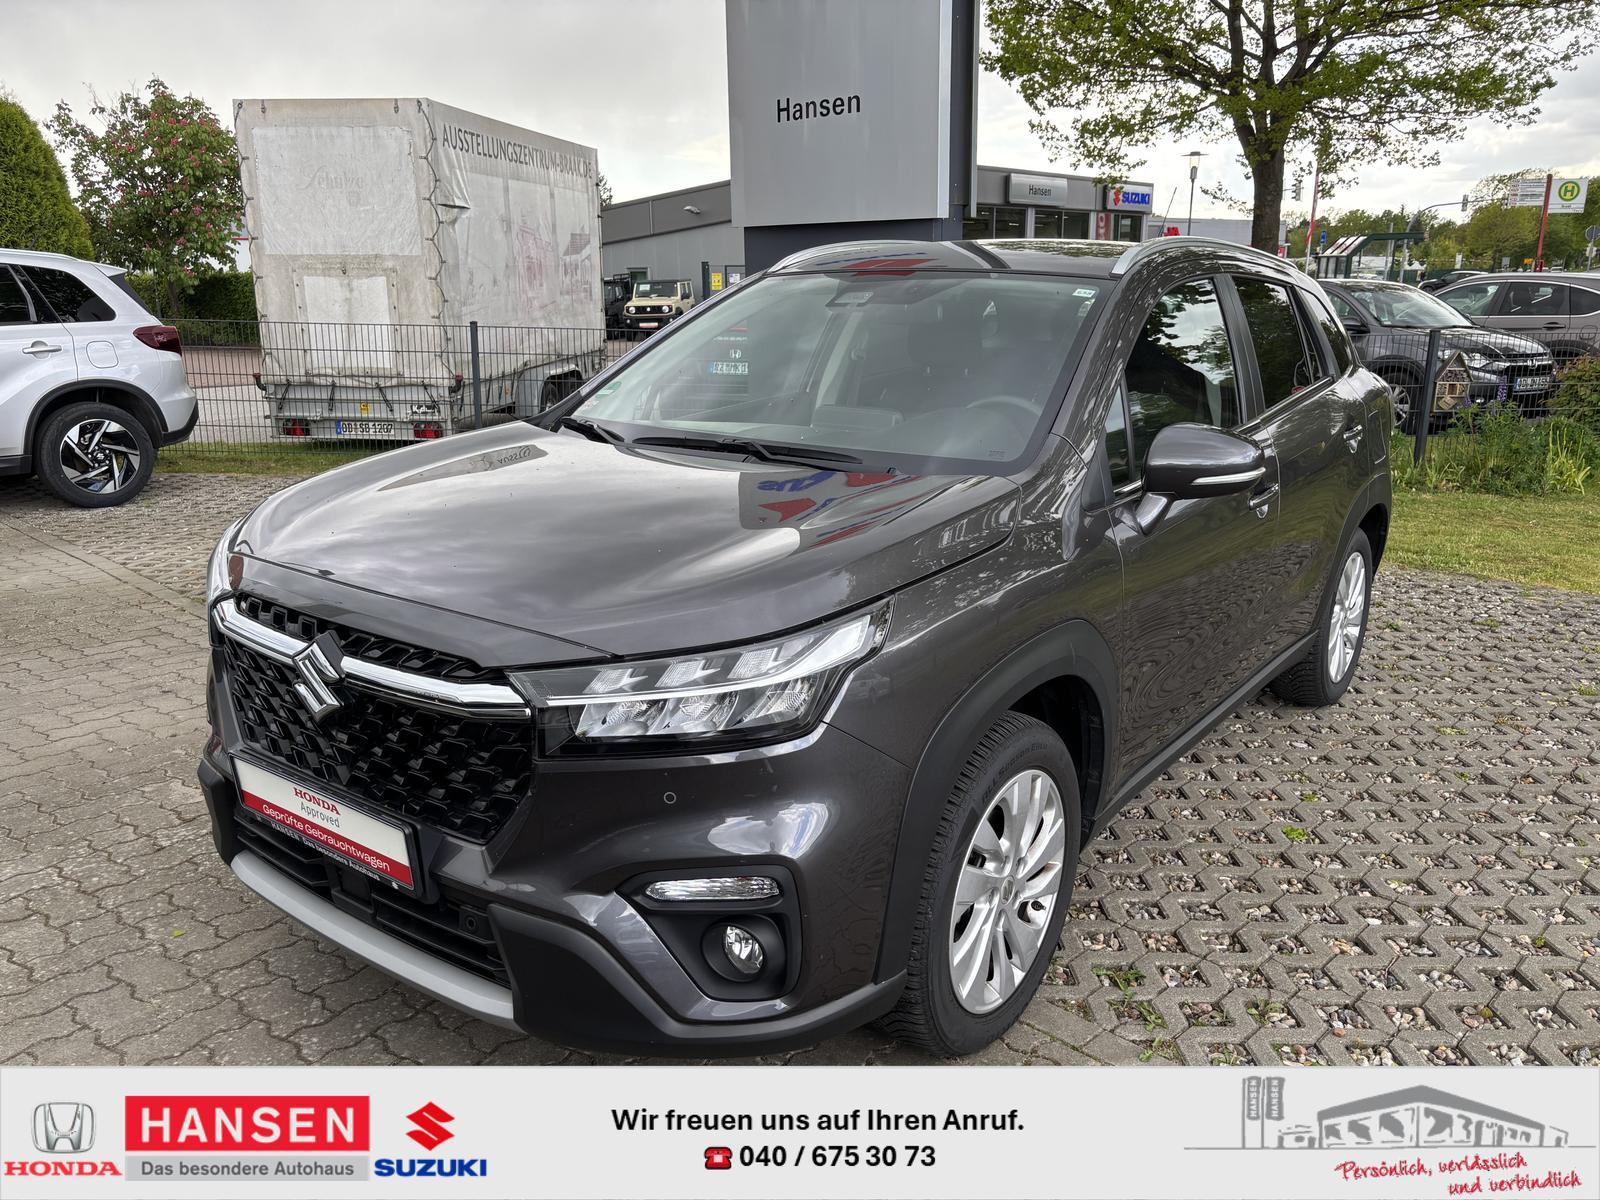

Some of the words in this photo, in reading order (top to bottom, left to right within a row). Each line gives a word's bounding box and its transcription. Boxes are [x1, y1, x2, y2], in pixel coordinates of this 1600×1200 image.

[776, 94, 861, 123] Hansen
[442, 123, 593, 180] AUSSTELLUNGSZENTRUM-BRAAK.DE
[1028, 184, 1052, 197] Hansen
[1121, 191, 1151, 205] SUZUKI
[293, 787, 341, 815] HONDA
[300, 801, 340, 828] Approved
[262, 804, 304, 831] Geprüfte
[304, 824, 391, 872] Gebrauchtwagen
